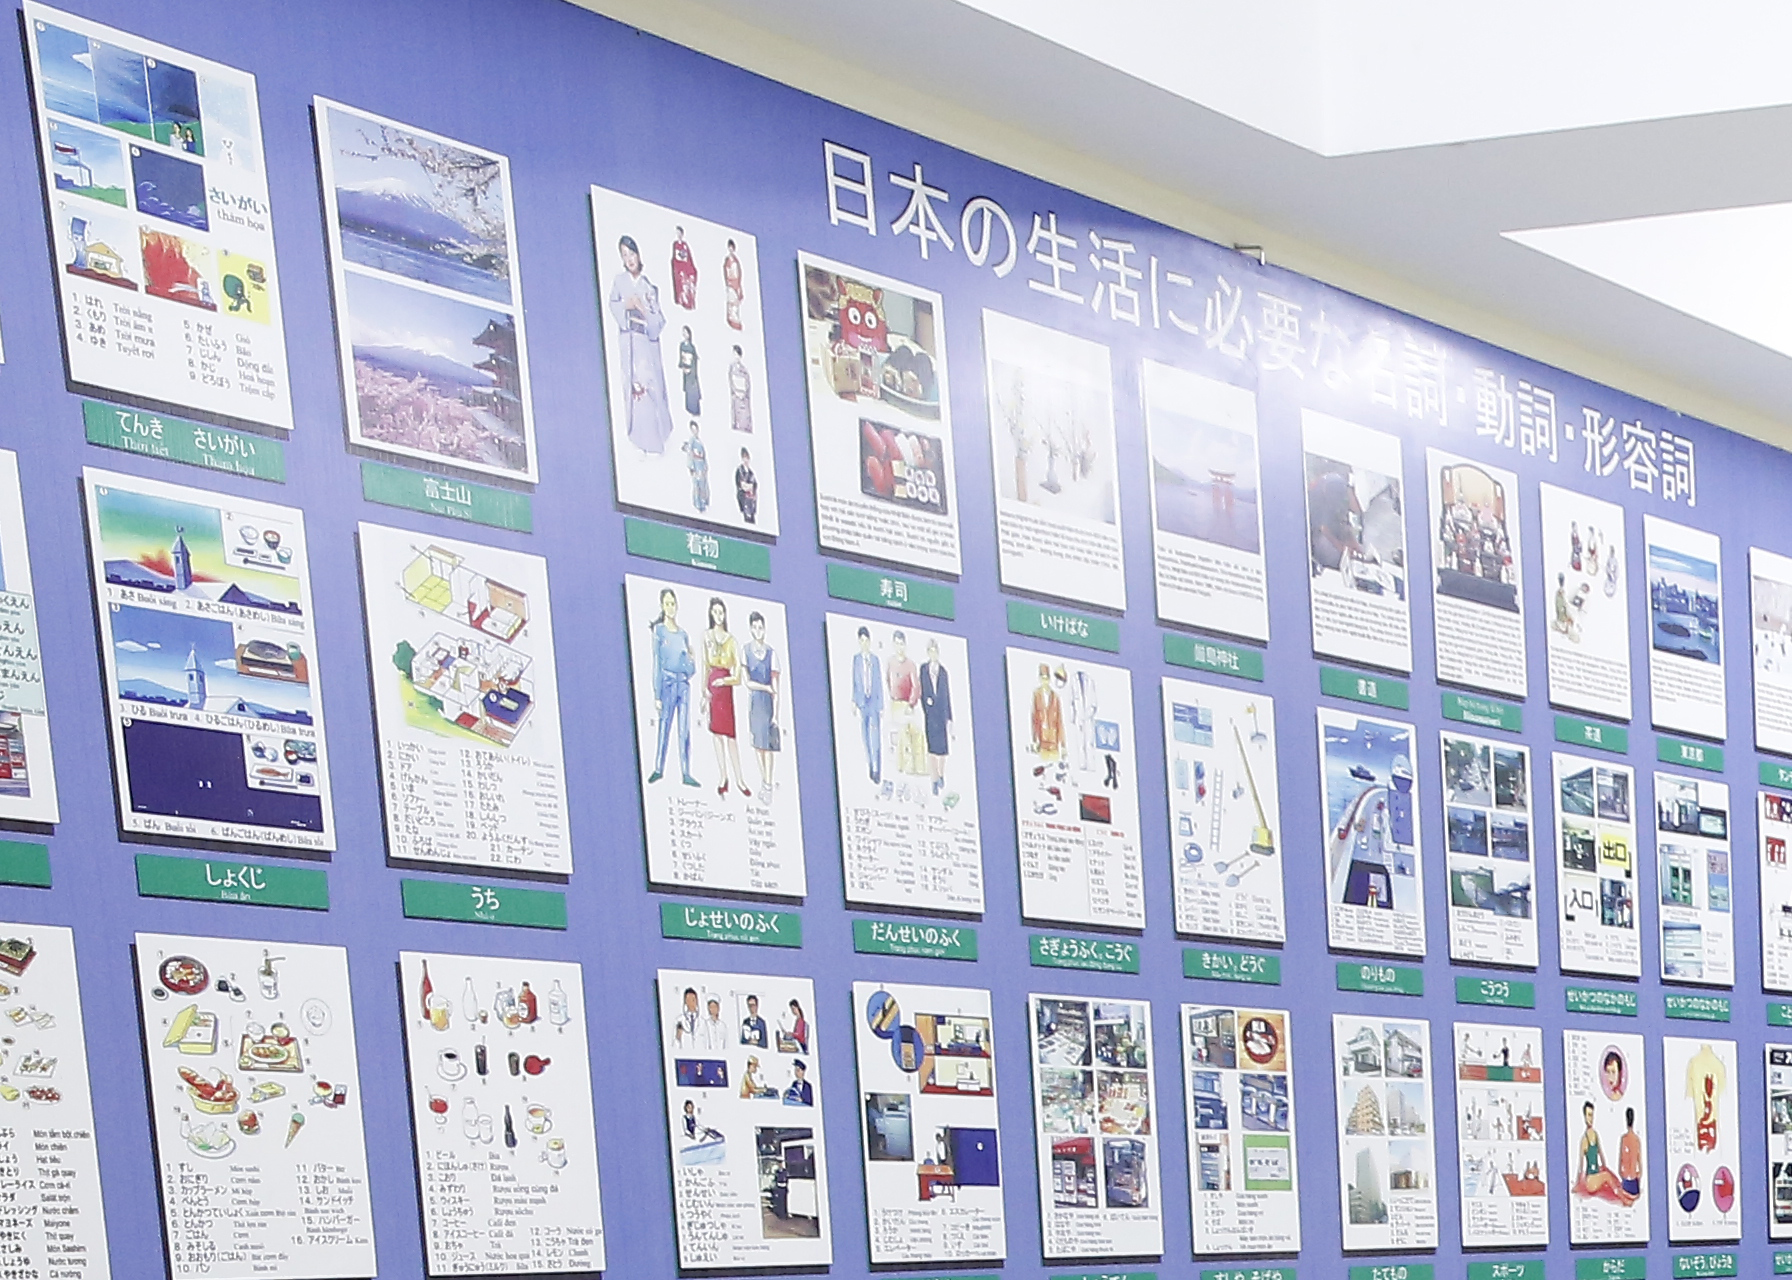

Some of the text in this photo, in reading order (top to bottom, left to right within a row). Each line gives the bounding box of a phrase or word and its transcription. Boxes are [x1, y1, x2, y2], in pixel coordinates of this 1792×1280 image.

[209, 186, 267, 214] さいがい
[116, 410, 255, 457] てんき さいがい
[423, 478, 471, 505] 富士山
[879, 578, 908, 602] 寿司
[205, 862, 266, 890] しょくじ
[471, 886, 500, 910] うち
[684, 907, 779, 933] じょせいのふく
[871, 922, 961, 947] だんせいのふく
[1492, 1263, 1525, 1279] スポーツ
